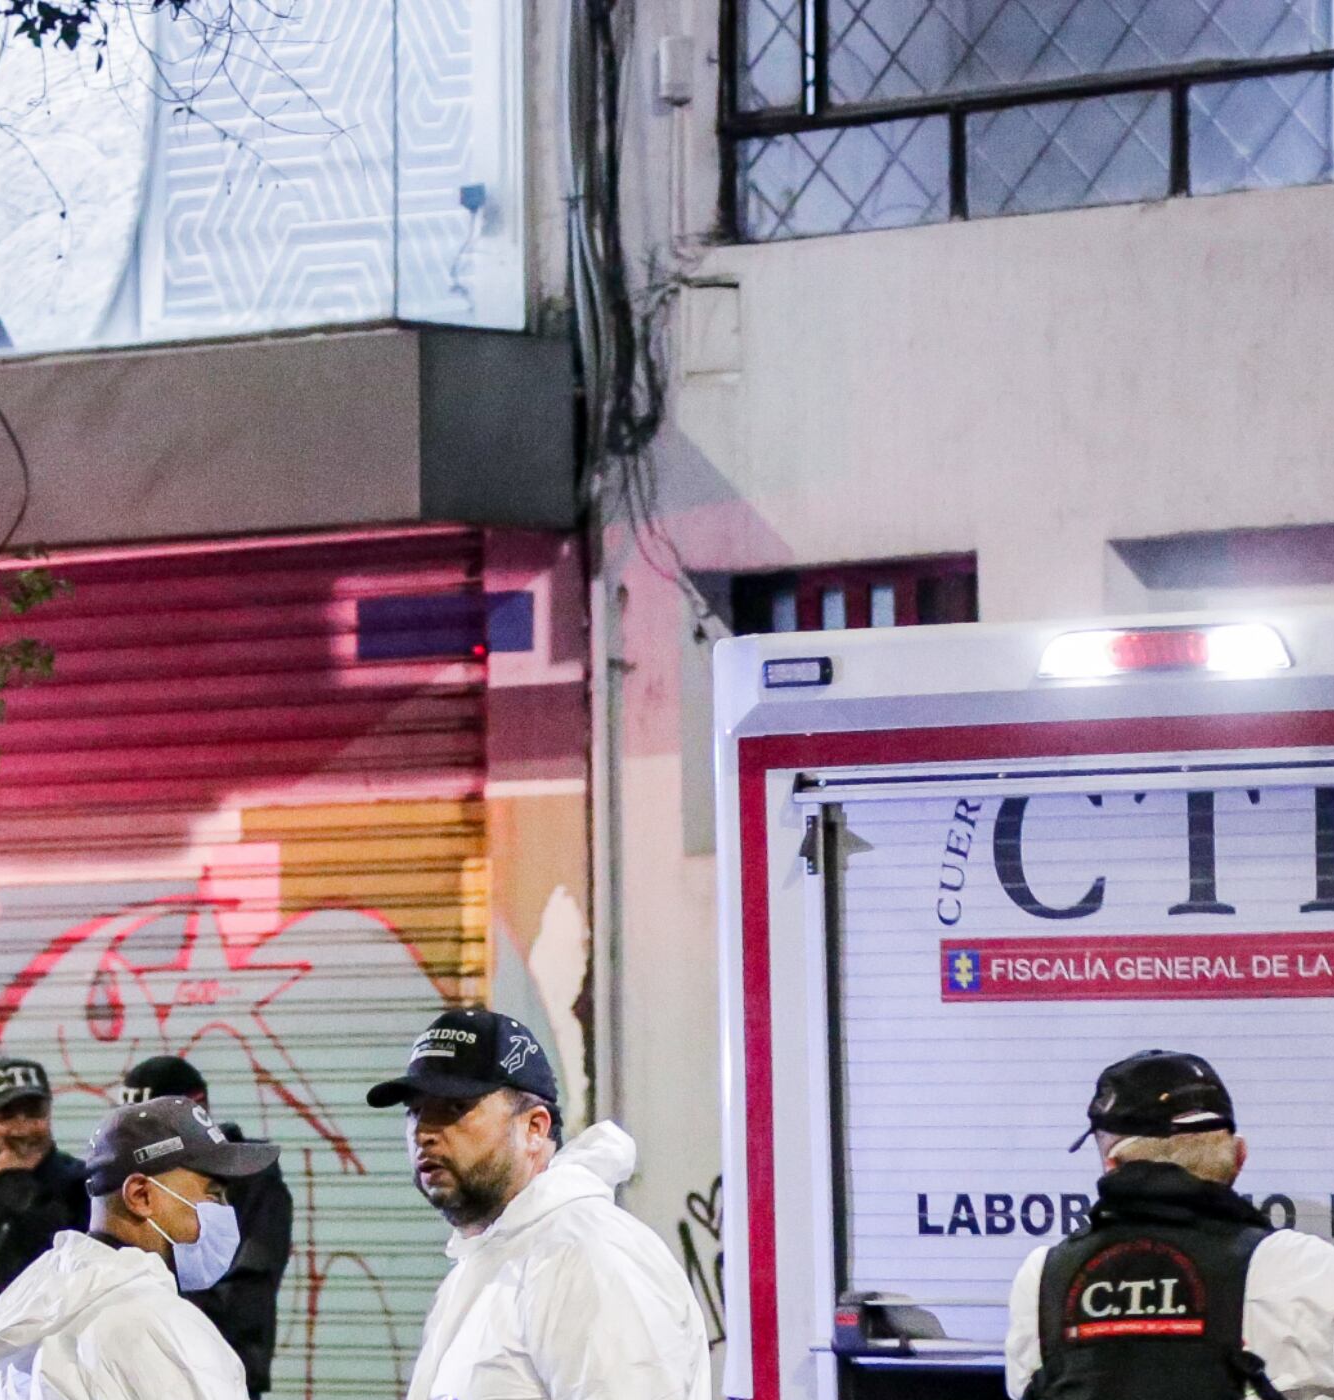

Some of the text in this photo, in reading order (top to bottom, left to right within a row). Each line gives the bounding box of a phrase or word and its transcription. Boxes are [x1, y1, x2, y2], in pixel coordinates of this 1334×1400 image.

[991, 952, 1110, 981] FISCALÍA
[1117, 956, 1245, 980] GENERAL
[1252, 956, 1289, 979] DE
[1081, 1278, 1187, 1318] C.T.I.
